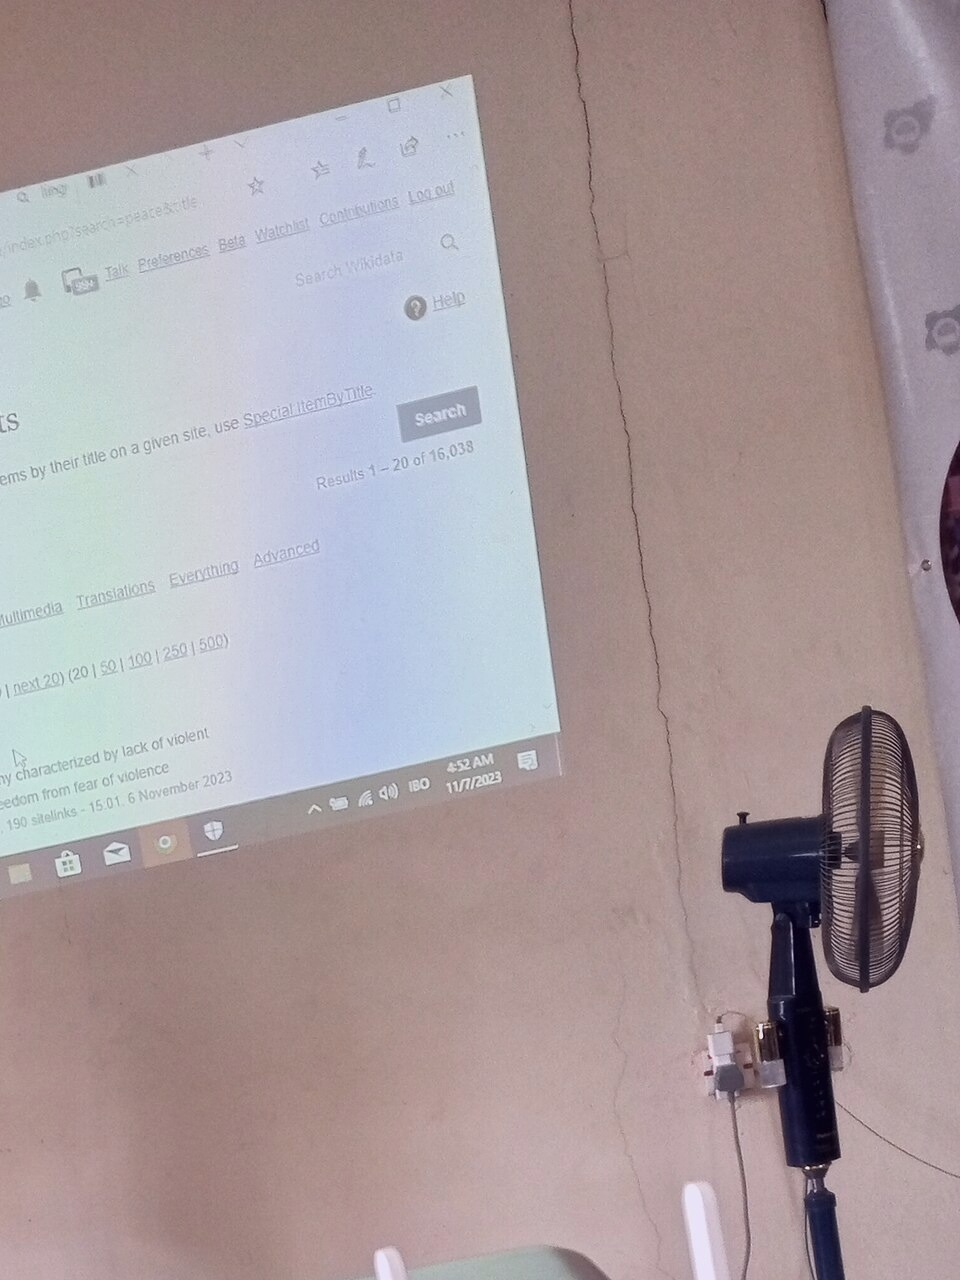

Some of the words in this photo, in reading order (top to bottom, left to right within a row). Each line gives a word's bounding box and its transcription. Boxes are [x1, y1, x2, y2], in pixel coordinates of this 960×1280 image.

[105, 264, 130, 282] Talk
[137, 243, 211, 273] Preferences
[218, 233, 247, 253] Beta
[254, 217, 310, 244] Watchlist
[319, 195, 400, 228] Contributions
[407, 189, 432, 206] Log
[434, 180, 457, 199] out
[295, 264, 342, 288] Search
[344, 250, 405, 278] Wikidata
[431, 289, 466, 312] Help
[414, 402, 468, 428] Search
[30, 464, 47, 483] by
[49, 454, 80, 475] their
[82, 447, 107, 467] title
[109, 445, 128, 460] on
[130, 442, 141, 456] a
[143, 431, 179, 456] given
[214, 416, 240, 433] use
[316, 466, 366, 492] Results
[367, 464, 377, 479] 1
[392, 456, 410, 473] 20
[412, 451, 427, 467] of
[429, 438, 476, 465] 16,038
[253, 538, 321, 569] Advanced
[168, 557, 241, 589] Everything
[76, 576, 157, 611] Translations
[13, 677, 42, 698] next
[42, 670, 66, 690] 20)
[68, 666, 89, 684] (20
[100, 658, 118, 677] 50
[127, 650, 154, 671] 100
[162, 642, 189, 662] 250
[197, 633, 230, 653] 500)
[15, 750, 102, 783] characterized
[103, 749, 121, 767] by
[122, 739, 150, 759] lack
[151, 736, 164, 752] of
[166, 726, 210, 748] violent
[445, 757, 472, 774] 4:52
[472, 752, 495, 769] AM
[42, 783, 72, 802] from
[72, 776, 99, 794] fear
[101, 772, 116, 788] of
[117, 761, 170, 785] violence
[445, 771, 503, 795] 11/7/2023
[6, 815, 29, 833] 190
[31, 805, 78, 828] sitelinks
[127, 791, 137, 805] 6
[139, 778, 201, 802] November
[203, 769, 234, 788] 2023
